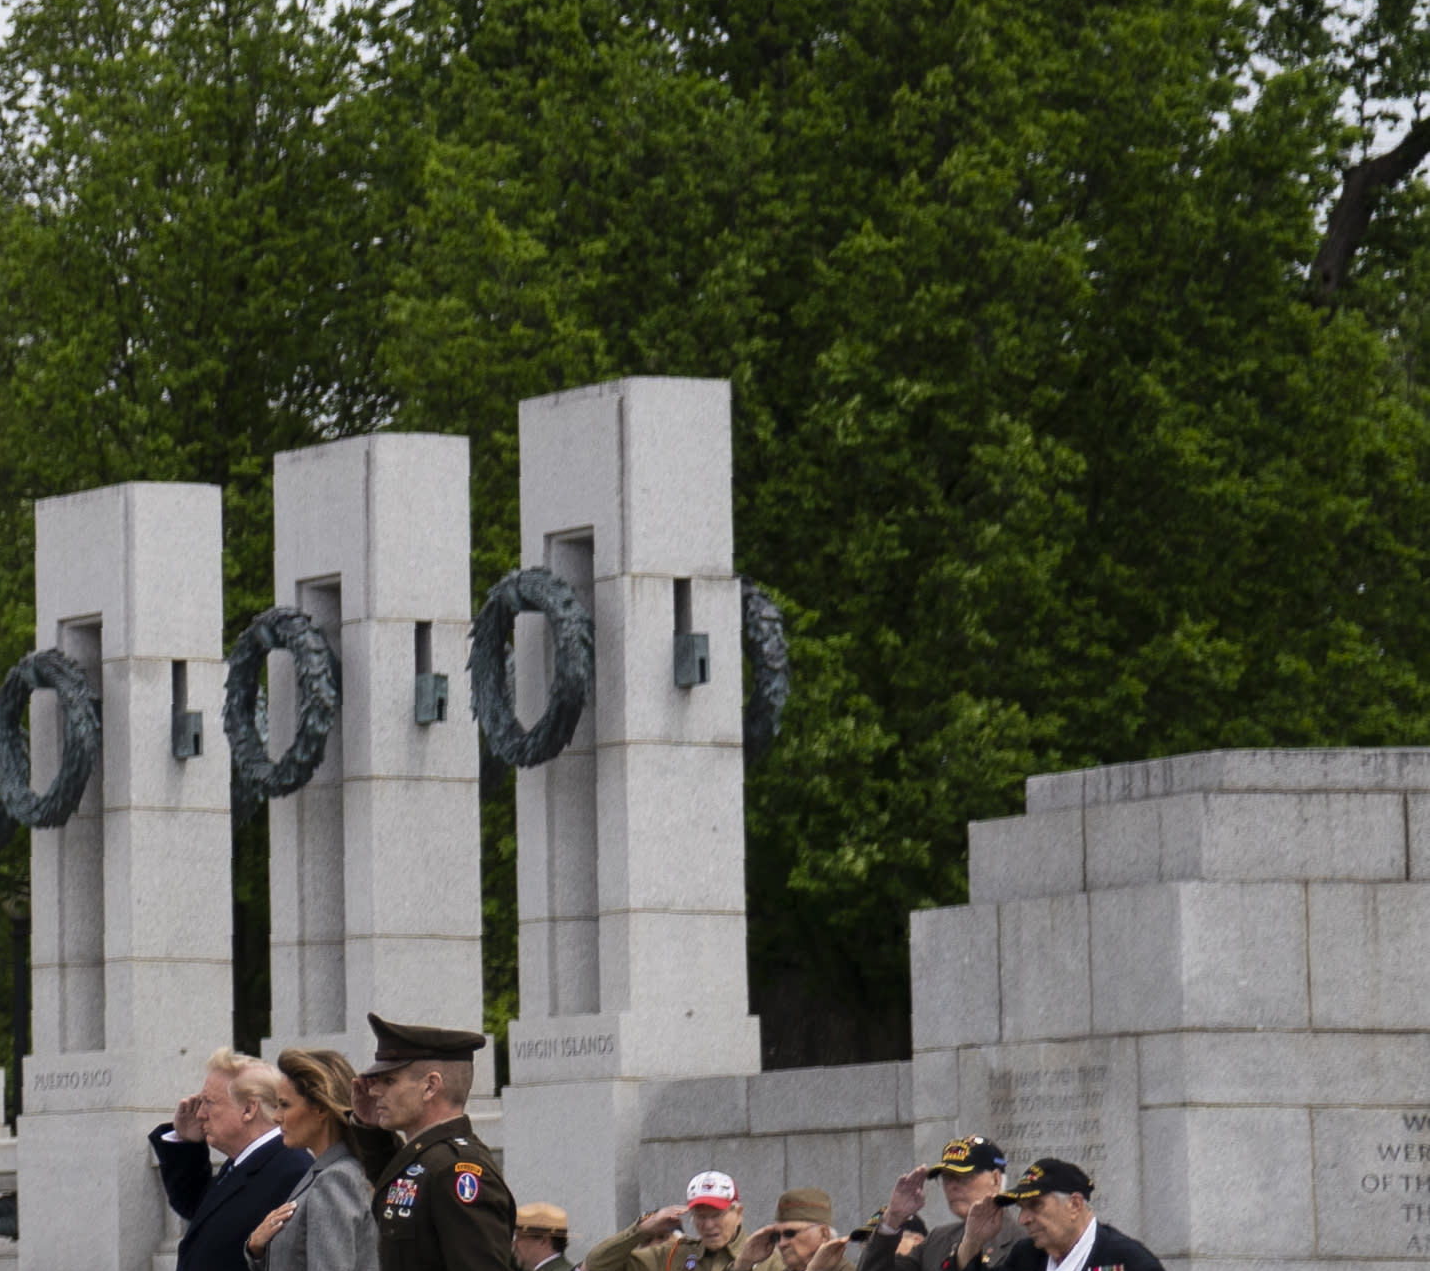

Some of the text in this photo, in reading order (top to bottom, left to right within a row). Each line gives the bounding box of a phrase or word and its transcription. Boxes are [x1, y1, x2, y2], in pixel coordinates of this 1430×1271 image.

[514, 1033, 613, 1059] VIRGIN ISLANDS
[34, 1069, 112, 1091] PUERTO RICO
[1378, 1143, 1430, 1163] WER
[1362, 1173, 1430, 1193] OF TH
[1401, 1203, 1430, 1223] TH
